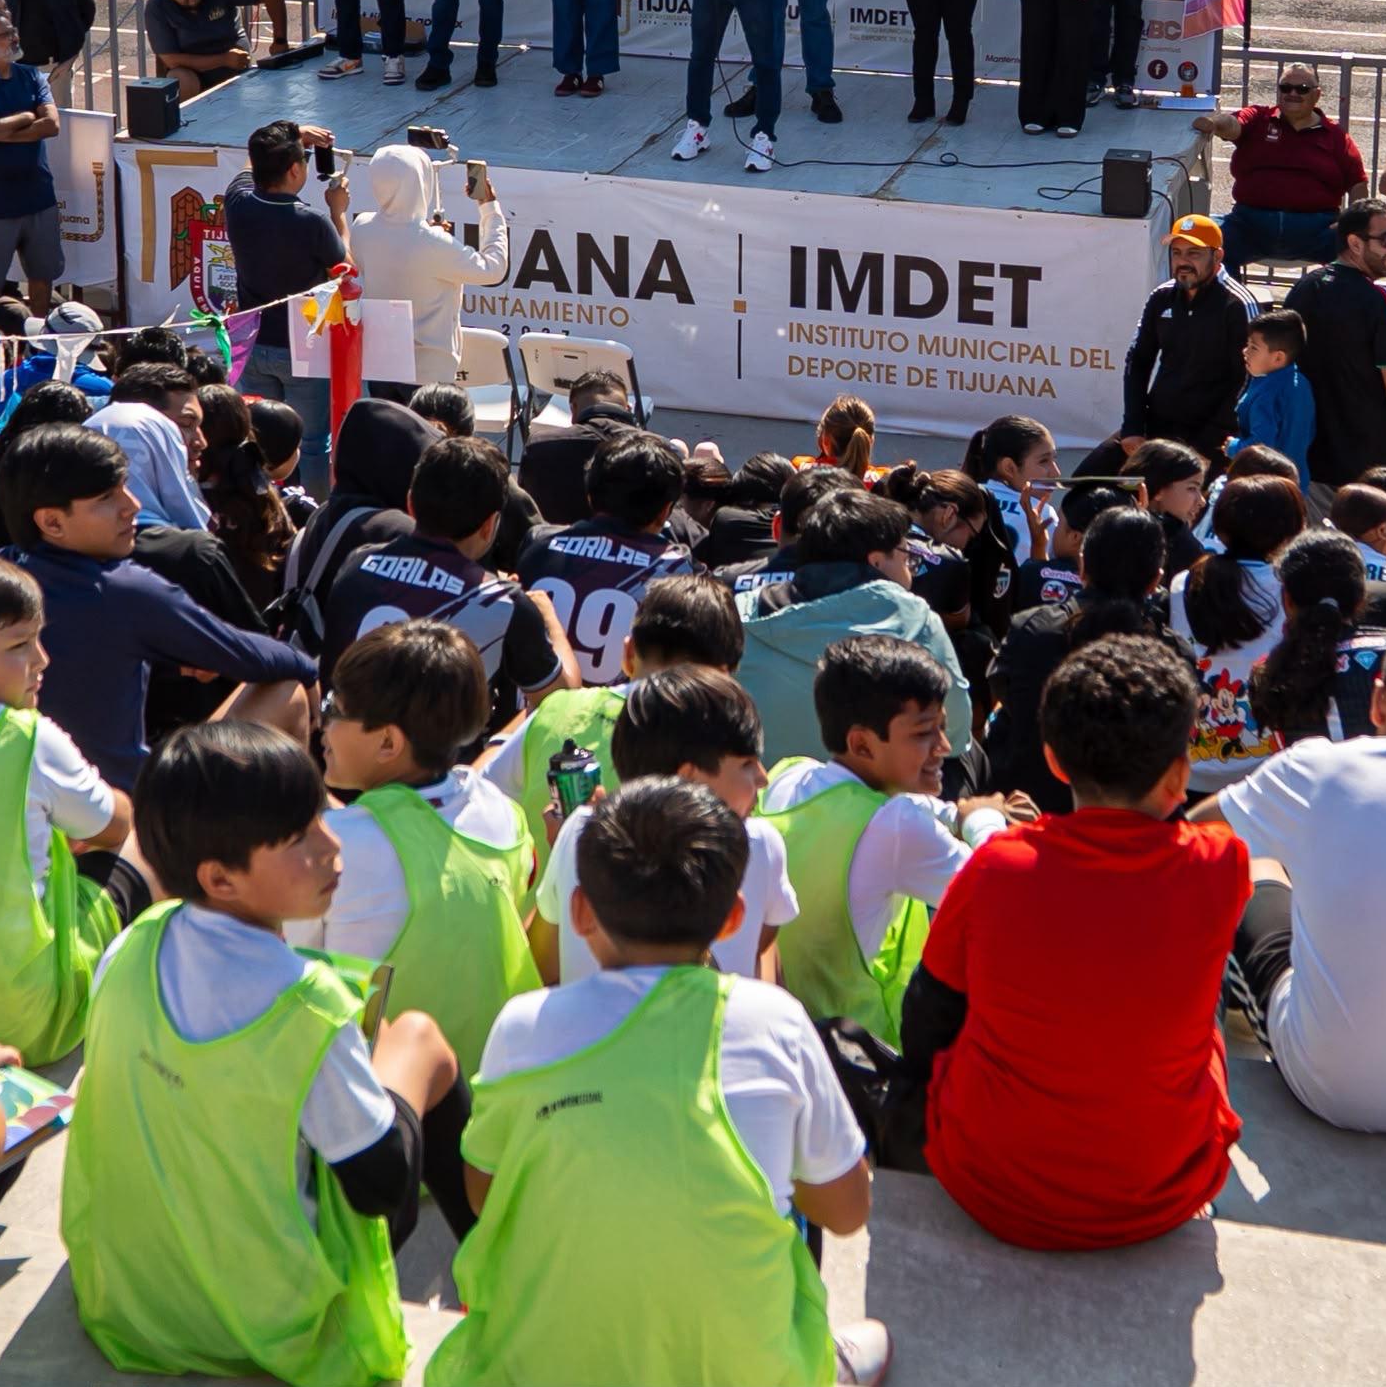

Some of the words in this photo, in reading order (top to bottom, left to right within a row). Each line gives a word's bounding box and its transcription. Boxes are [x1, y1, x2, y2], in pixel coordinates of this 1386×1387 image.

[850, 7, 909, 26] IMDET
[464, 223, 695, 305] UANA
[790, 245, 1043, 328] IMDET
[462, 293, 630, 327] UNTAMIENTO
[788, 322, 909, 353] INSTITUTO
[918, 334, 1061, 366] MUNICIPAL
[1070, 347, 1116, 371] DEL
[788, 355, 897, 385] DEPORTE
[907, 366, 938, 389] DE
[946, 369, 1057, 399] TIJUANA
[548, 535, 651, 567] GORILAS
[360, 554, 465, 596] GORILAS
